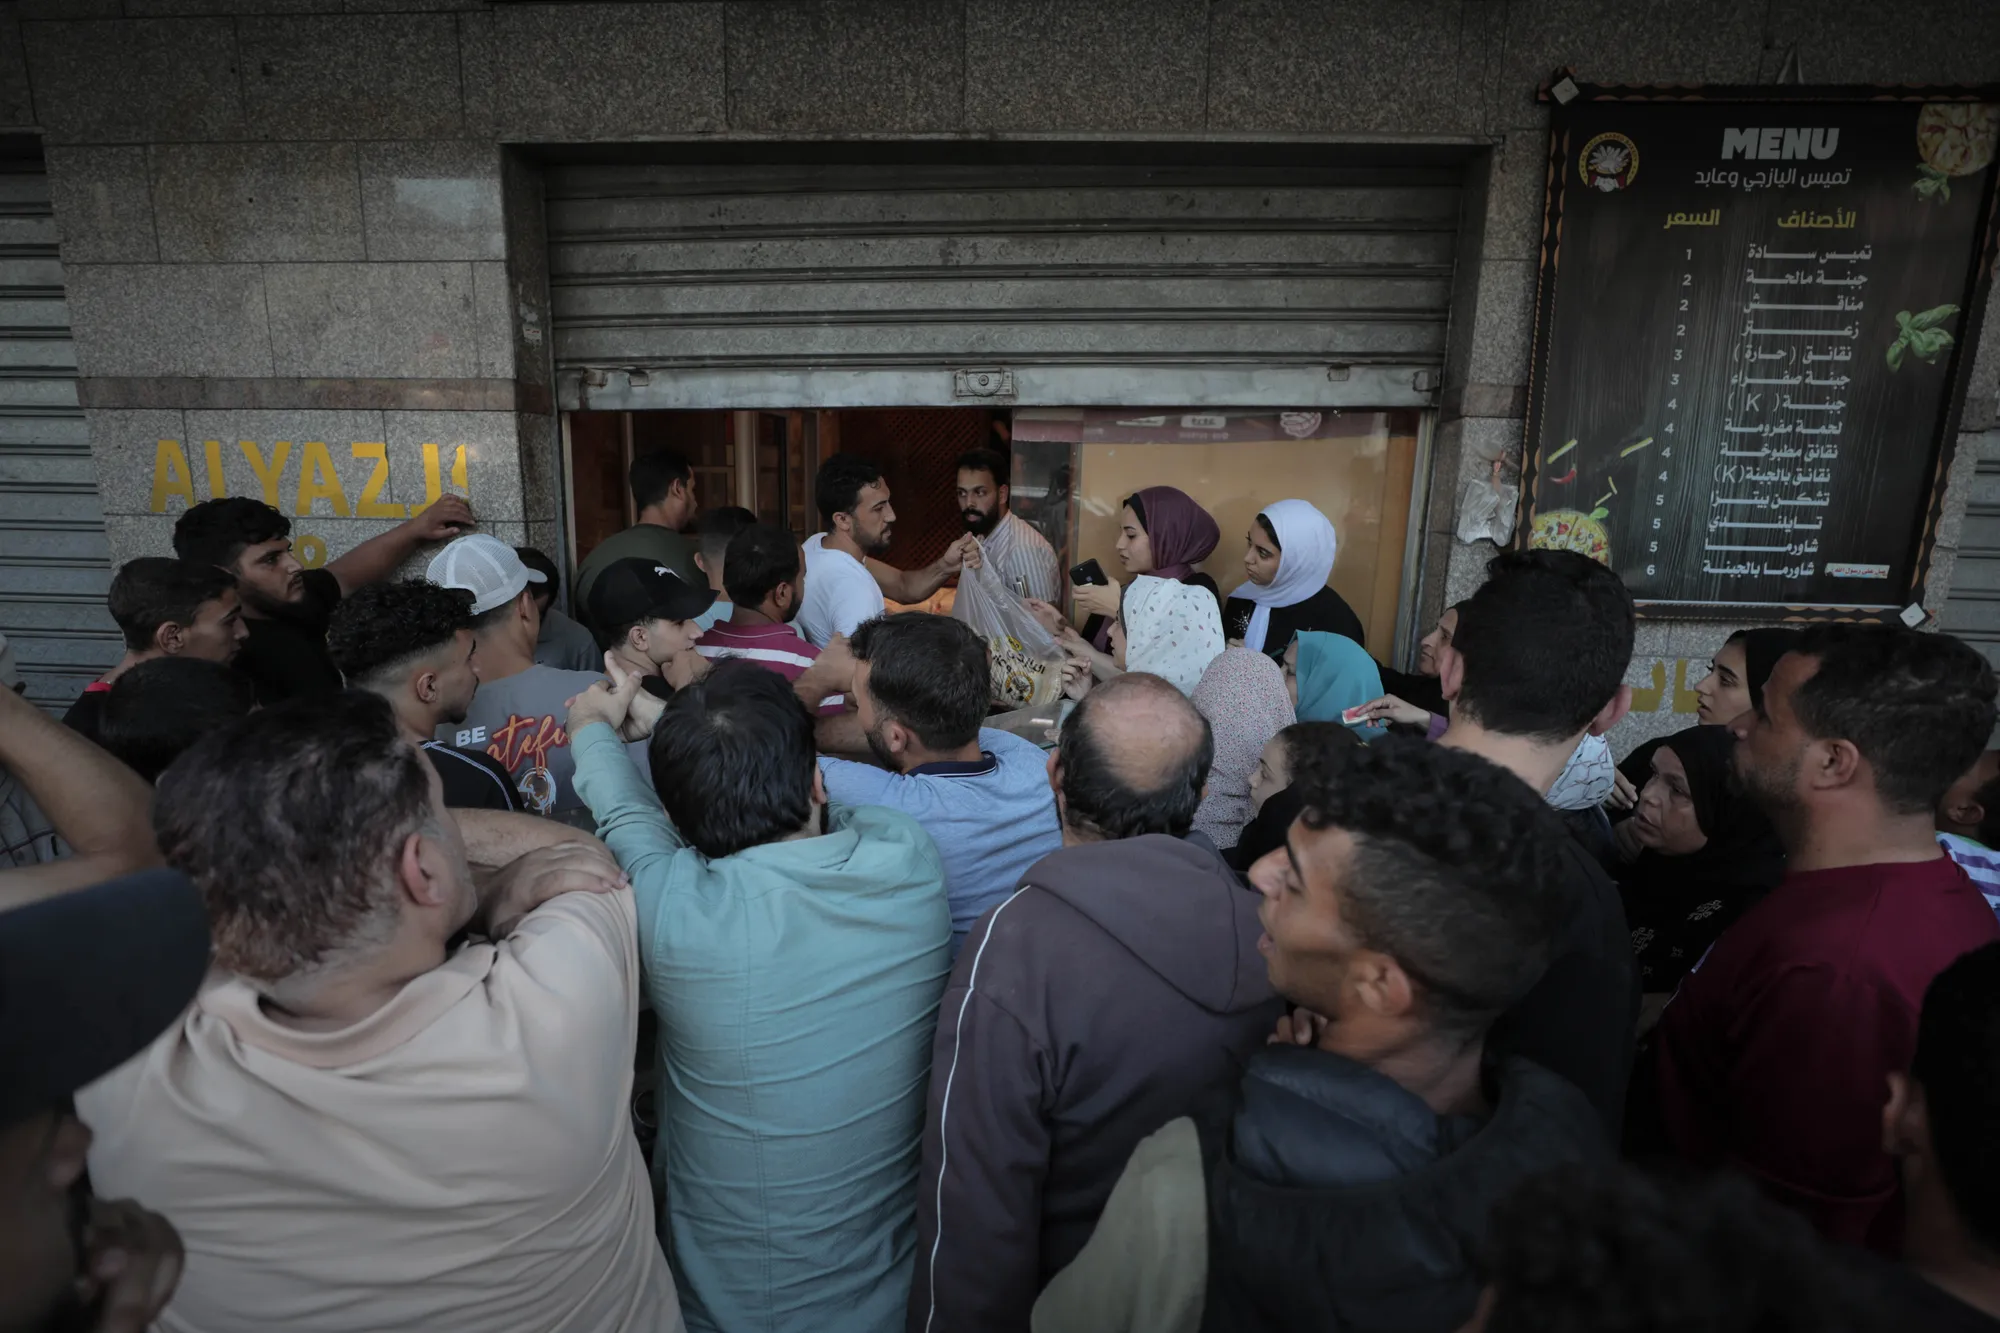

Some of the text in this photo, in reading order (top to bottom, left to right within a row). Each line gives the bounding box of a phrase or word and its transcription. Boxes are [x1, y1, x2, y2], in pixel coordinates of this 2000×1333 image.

[1721, 127, 1840, 160] MENU
[1694, 168, 1852, 192] تميس اليازجي وعابد
[1663, 208, 1721, 230] السعر
[1776, 207, 1857, 229] الأصناف
[1685, 248, 1692, 261] 1
[1747, 243, 1872, 264] تميس سادة
[1682, 274, 1692, 286] 2
[1745, 268, 1868, 290] جبنة مالحة
[1679, 299, 1689, 311] 2
[1676, 325, 1685, 336] 2
[1740, 319, 1860, 339] زعتر
[1673, 349, 1683, 361] 3
[1802, 345, 1852, 364] نقانق
[1670, 374, 1680, 385] 3
[1730, 370, 1851, 390] جبنة صفراء
[1667, 398, 1677, 410] 4
[1782, 395, 1847, 415] جبنة
[1664, 423, 1674, 434] 4
[1723, 418, 1843, 437] لحمة مفرومة
[1661, 447, 1671, 458] 4
[1719, 442, 1838, 463] نقانق مطبوخة
[1658, 471, 1668, 482] 4
[1792, 468, 1831, 487] نقانق
[1655, 494, 1665, 506] 5
[1710, 490, 1831, 510] تشكن بيتزا
[1652, 518, 1662, 529] 5
[1707, 515, 1823, 533] تايلندي
[1649, 541, 1658, 553] 5
[1704, 537, 1819, 557] شاورما
[1646, 565, 1656, 576] 6
[1702, 559, 1815, 580] شاورما بالجبنة
[455, 713, 571, 776] BE atefu
